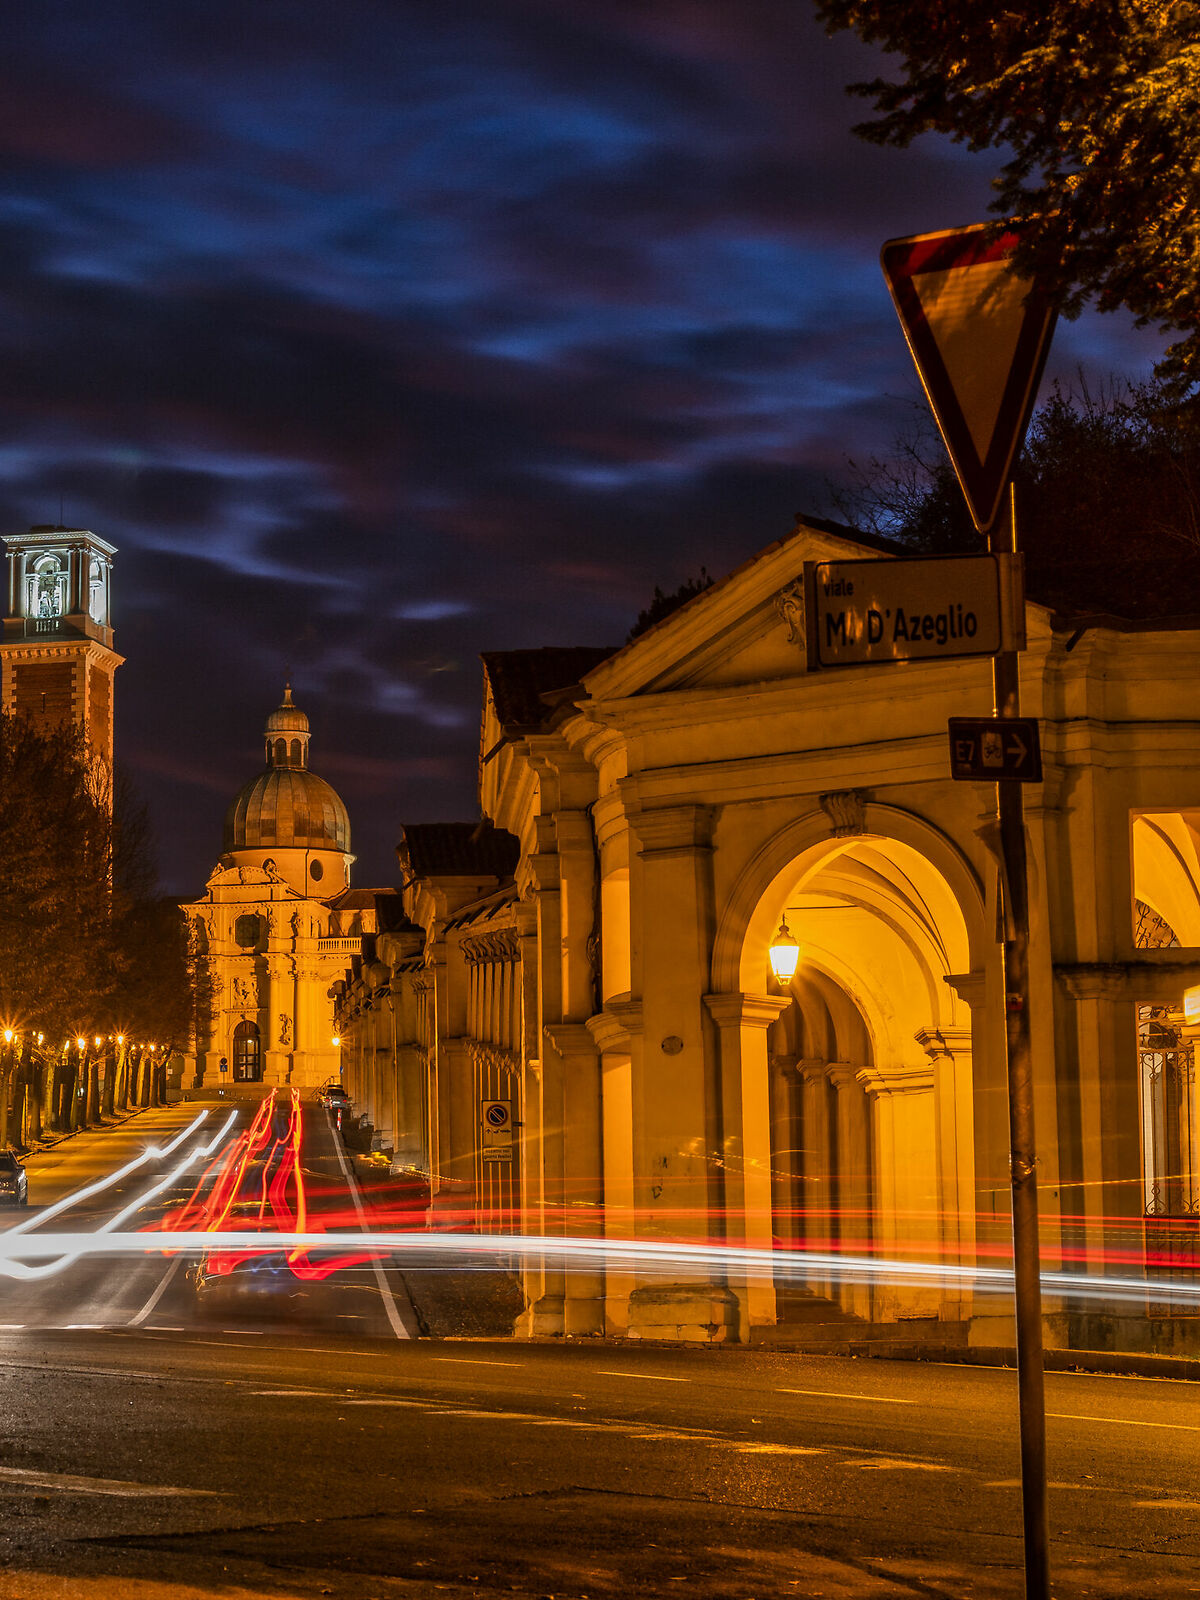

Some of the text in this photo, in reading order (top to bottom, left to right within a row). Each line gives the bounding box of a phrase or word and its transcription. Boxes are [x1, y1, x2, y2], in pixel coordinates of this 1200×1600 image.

[823, 579, 854, 598] viale
[827, 604, 977, 648] M. D'Azeglio
